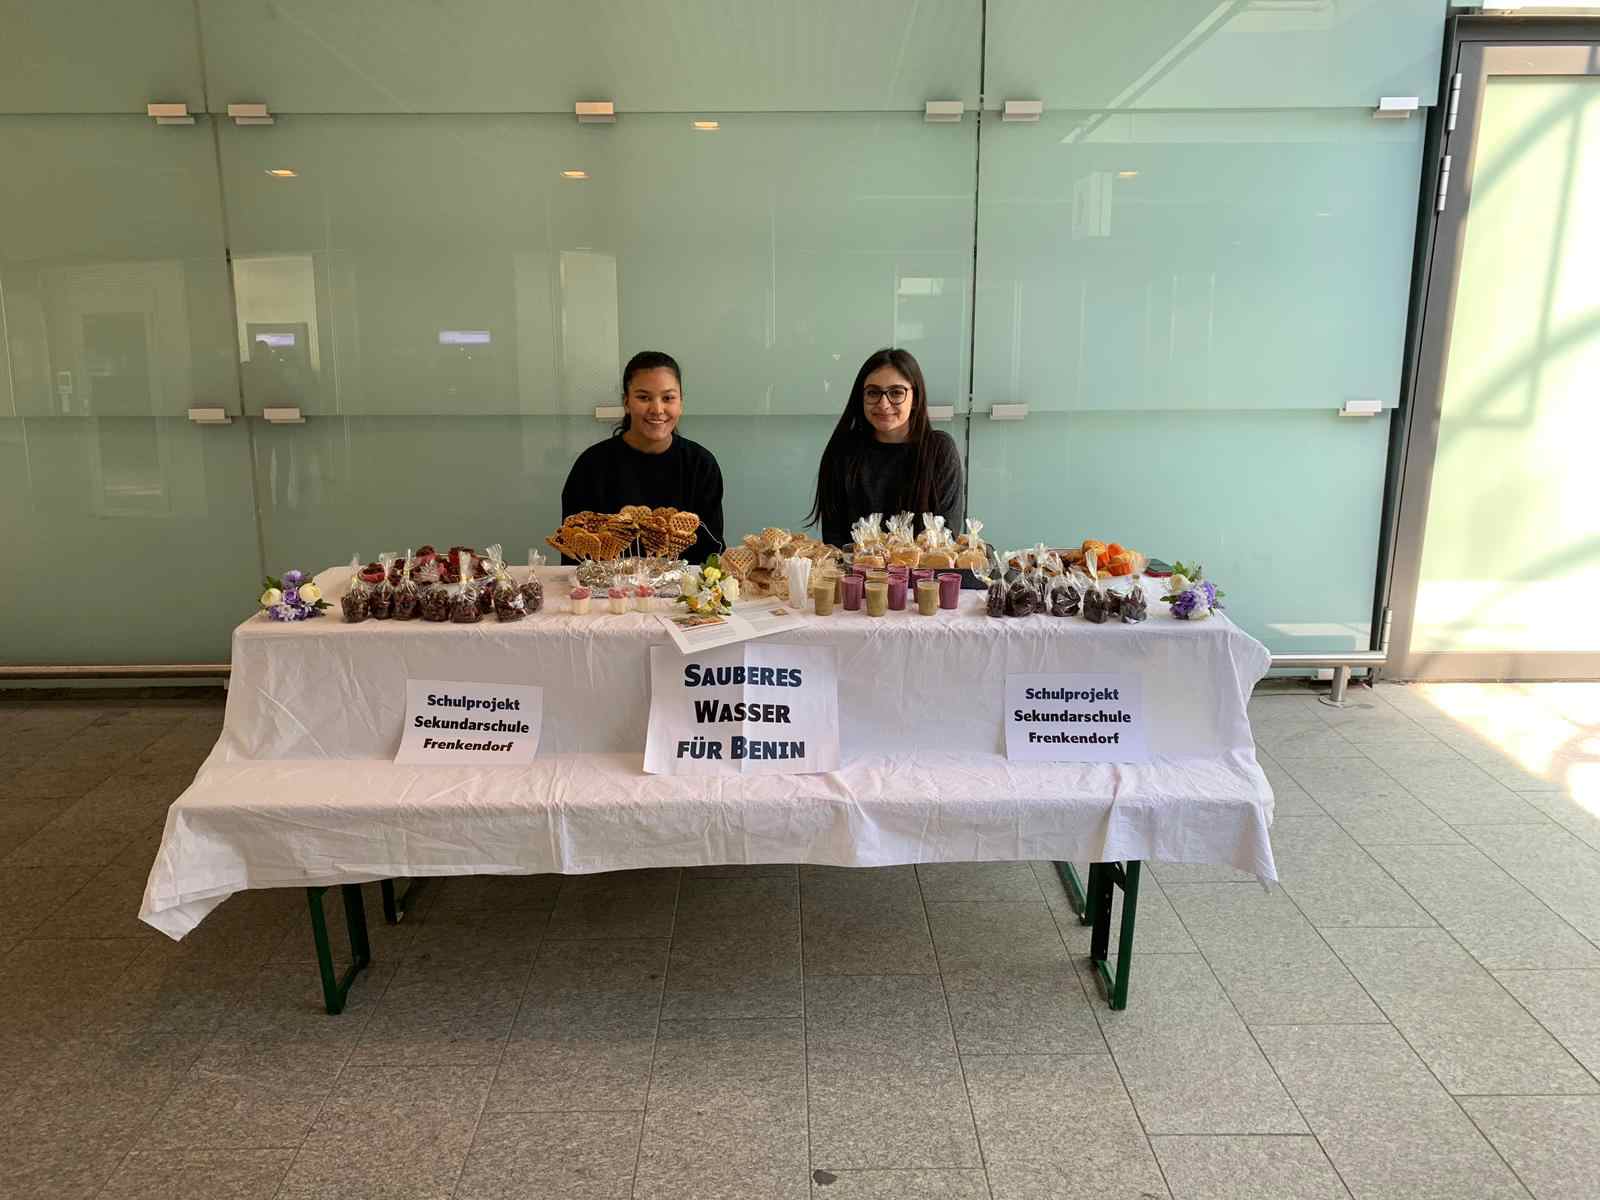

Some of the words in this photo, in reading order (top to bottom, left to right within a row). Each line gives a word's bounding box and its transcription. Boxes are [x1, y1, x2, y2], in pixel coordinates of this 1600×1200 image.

[684, 663, 802, 688] SAUBERES
[427, 694, 521, 712] Schulprojekt
[1025, 687, 1119, 703] Schulprojekt
[694, 700, 791, 724] WASSER
[1014, 709, 1132, 723] Sekundarschule
[414, 715, 530, 734] Sekundarschule
[423, 738, 514, 752] Frenkendorf
[1028, 731, 1120, 744] Frenkendorf
[676, 736, 723, 760] FÜR
[730, 736, 805, 760] BENIN
